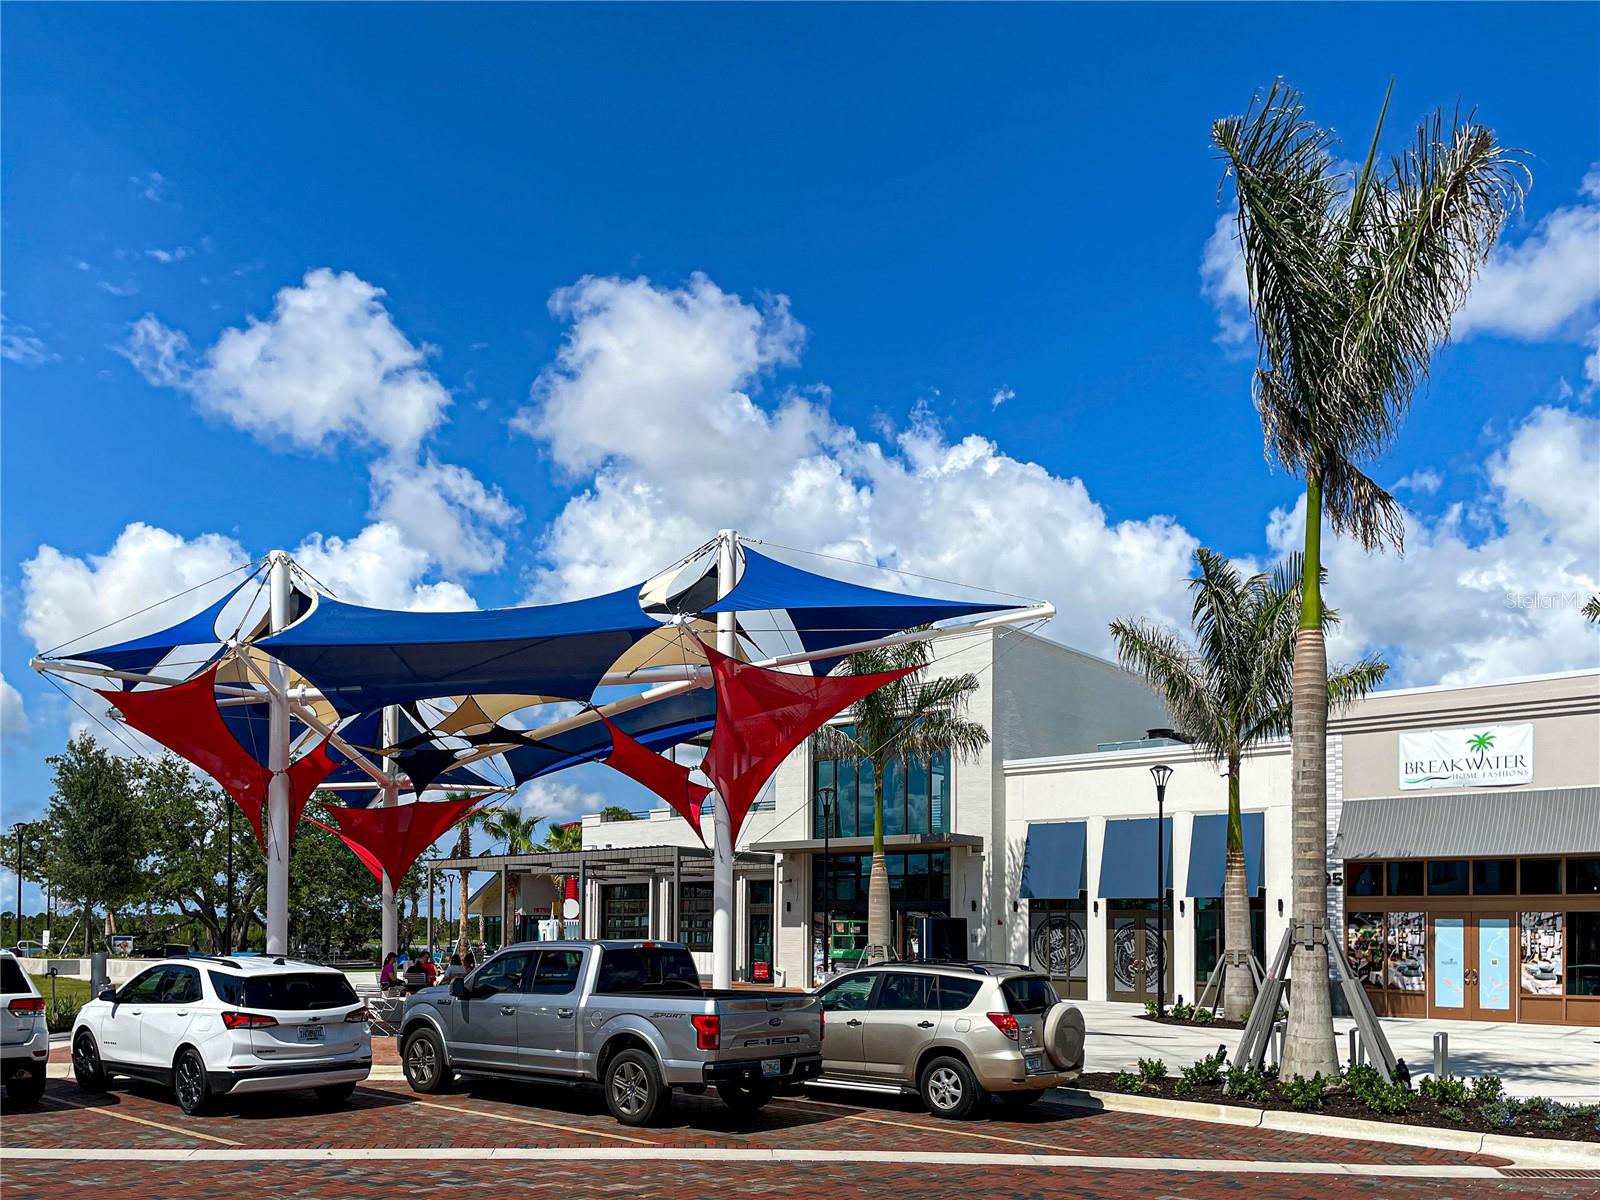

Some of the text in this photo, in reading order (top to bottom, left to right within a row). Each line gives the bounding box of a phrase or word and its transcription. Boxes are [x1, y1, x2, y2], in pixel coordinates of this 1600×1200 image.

[1405, 754, 1527, 774] BREAKWATER
[1452, 769, 1528, 780] HOME FASHIONS
[1127, 954, 1158, 977] SNE
[743, 1037, 800, 1047] F-150
